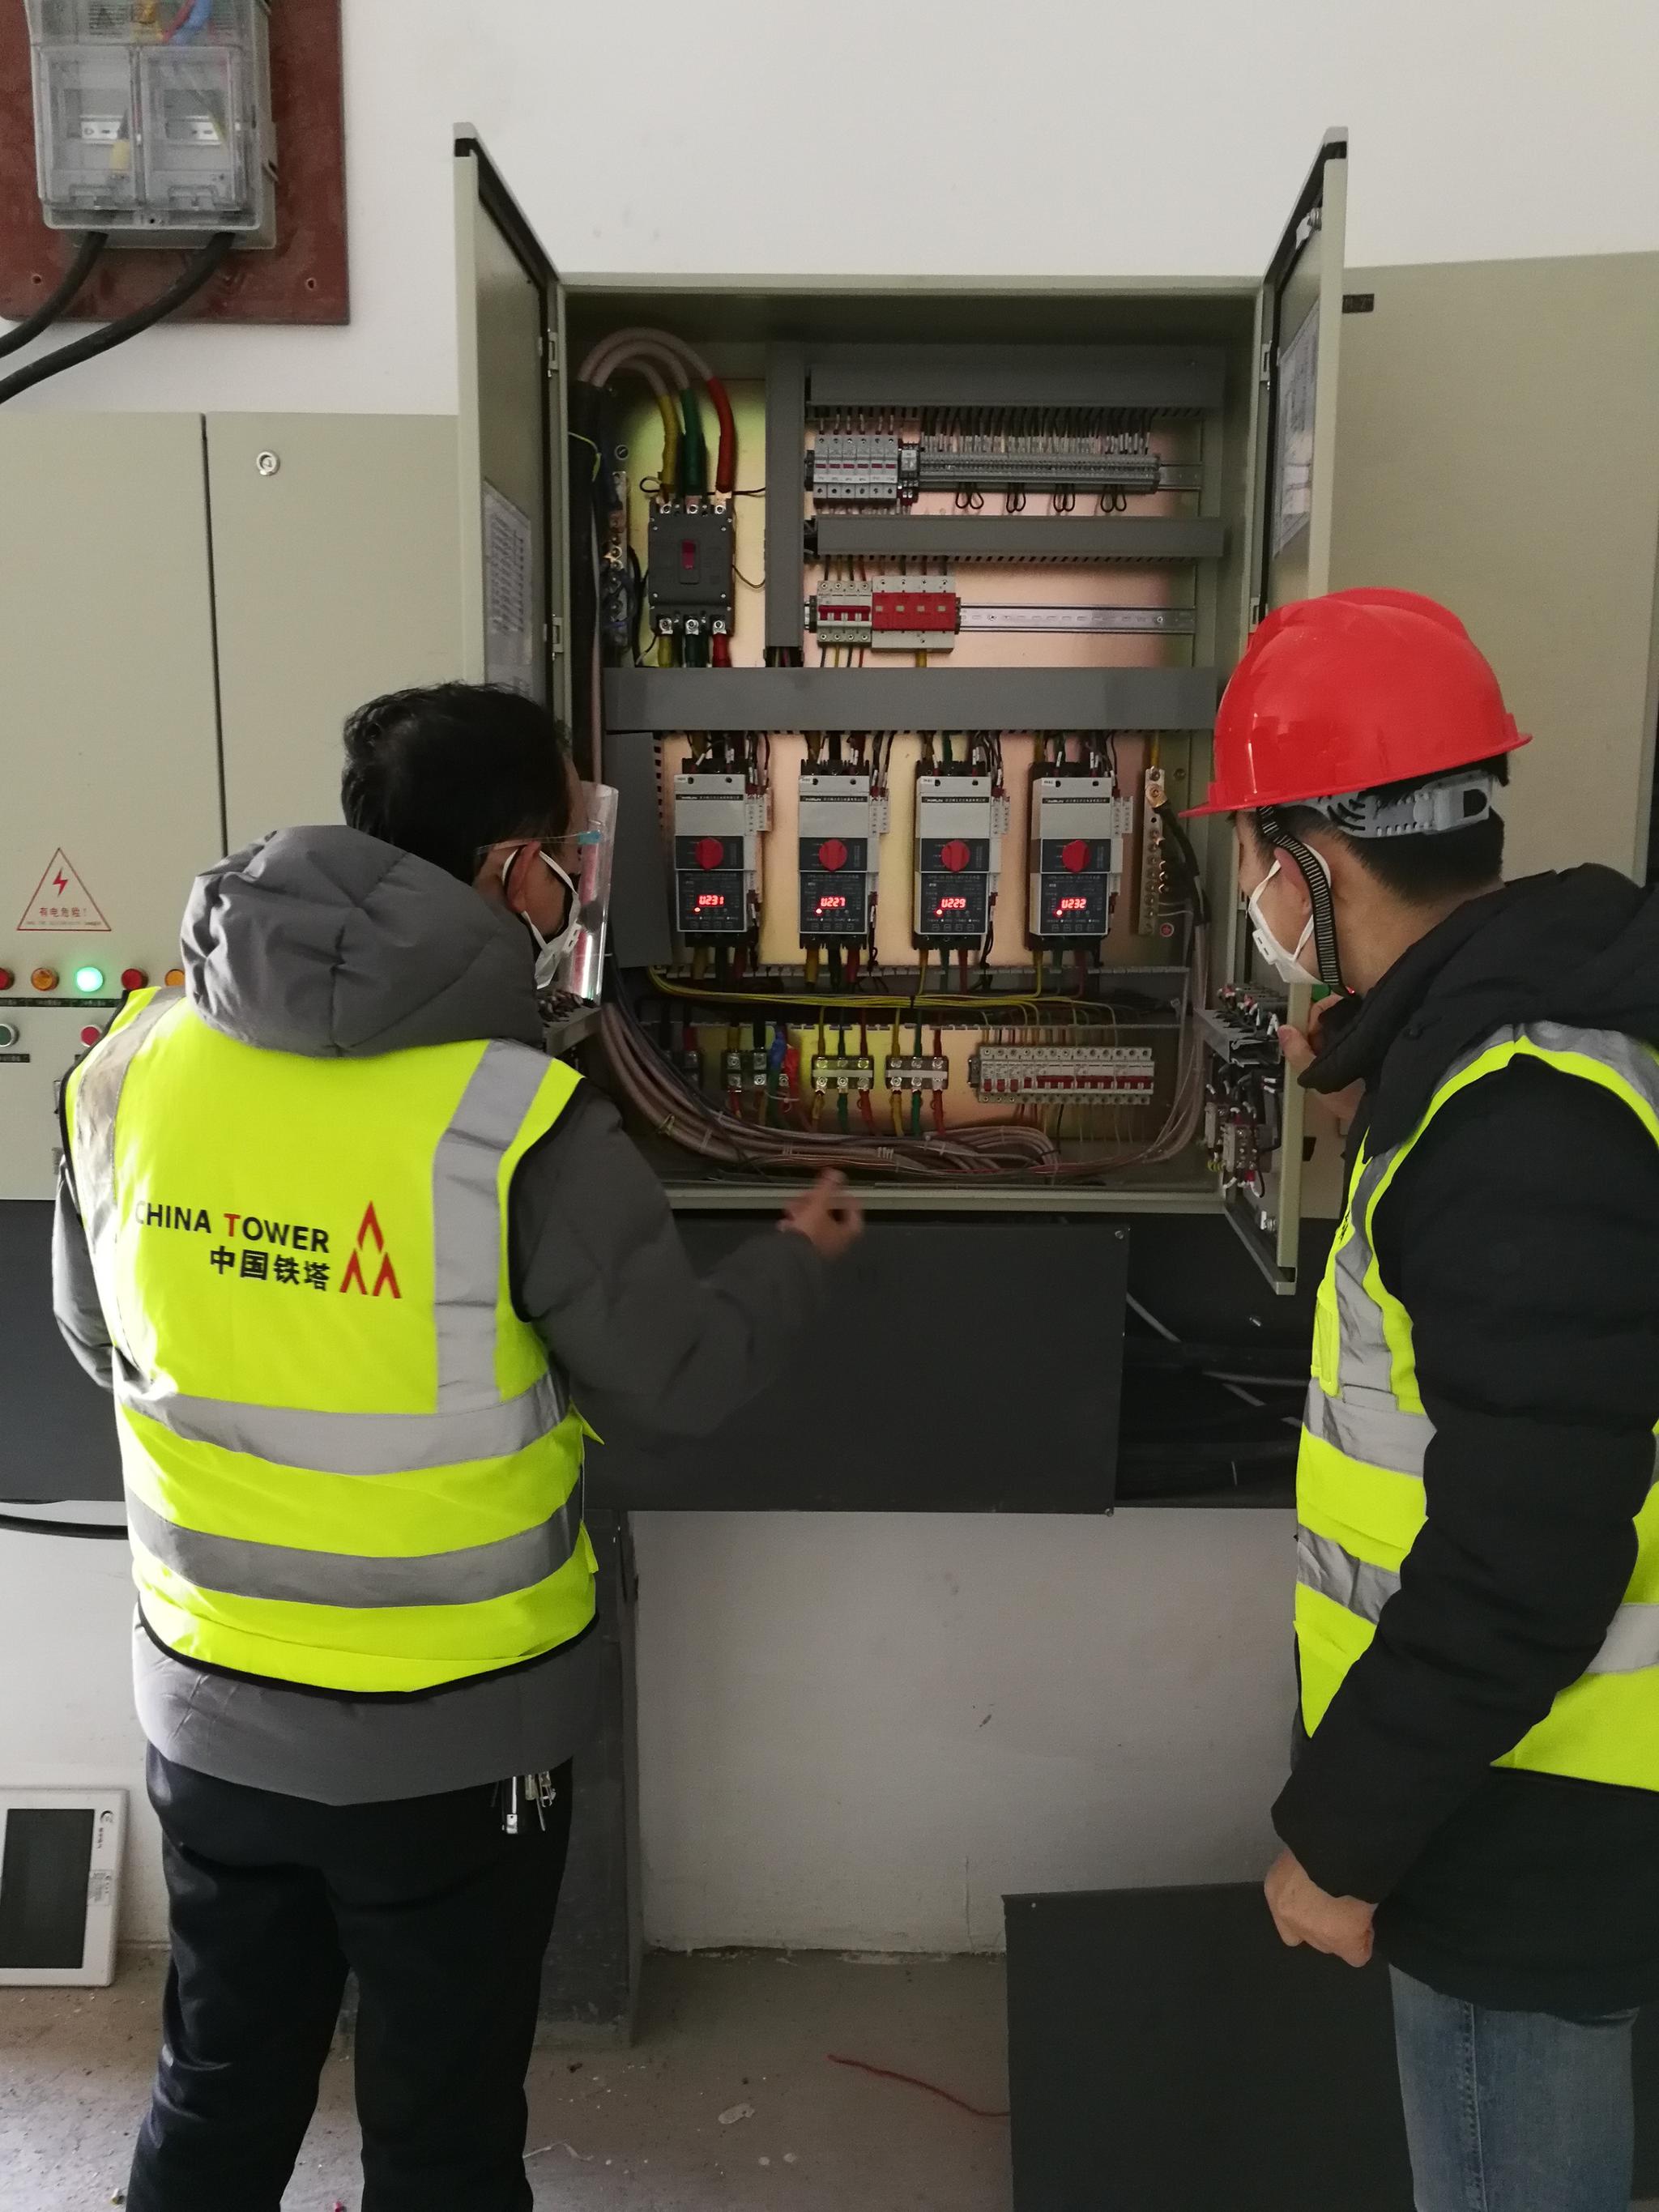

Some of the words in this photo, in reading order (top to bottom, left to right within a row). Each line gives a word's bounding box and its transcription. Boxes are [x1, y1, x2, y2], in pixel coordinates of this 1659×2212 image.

[699, 895, 724, 905] U231
[821, 897, 846, 906] U227
[941, 898, 966, 908] U229
[1061, 899, 1086, 908] U232
[135, 1200, 211, 1234] CHINA
[224, 1213, 330, 1253] TOWER
[210, 1245, 330, 1291] 中国铁塔
